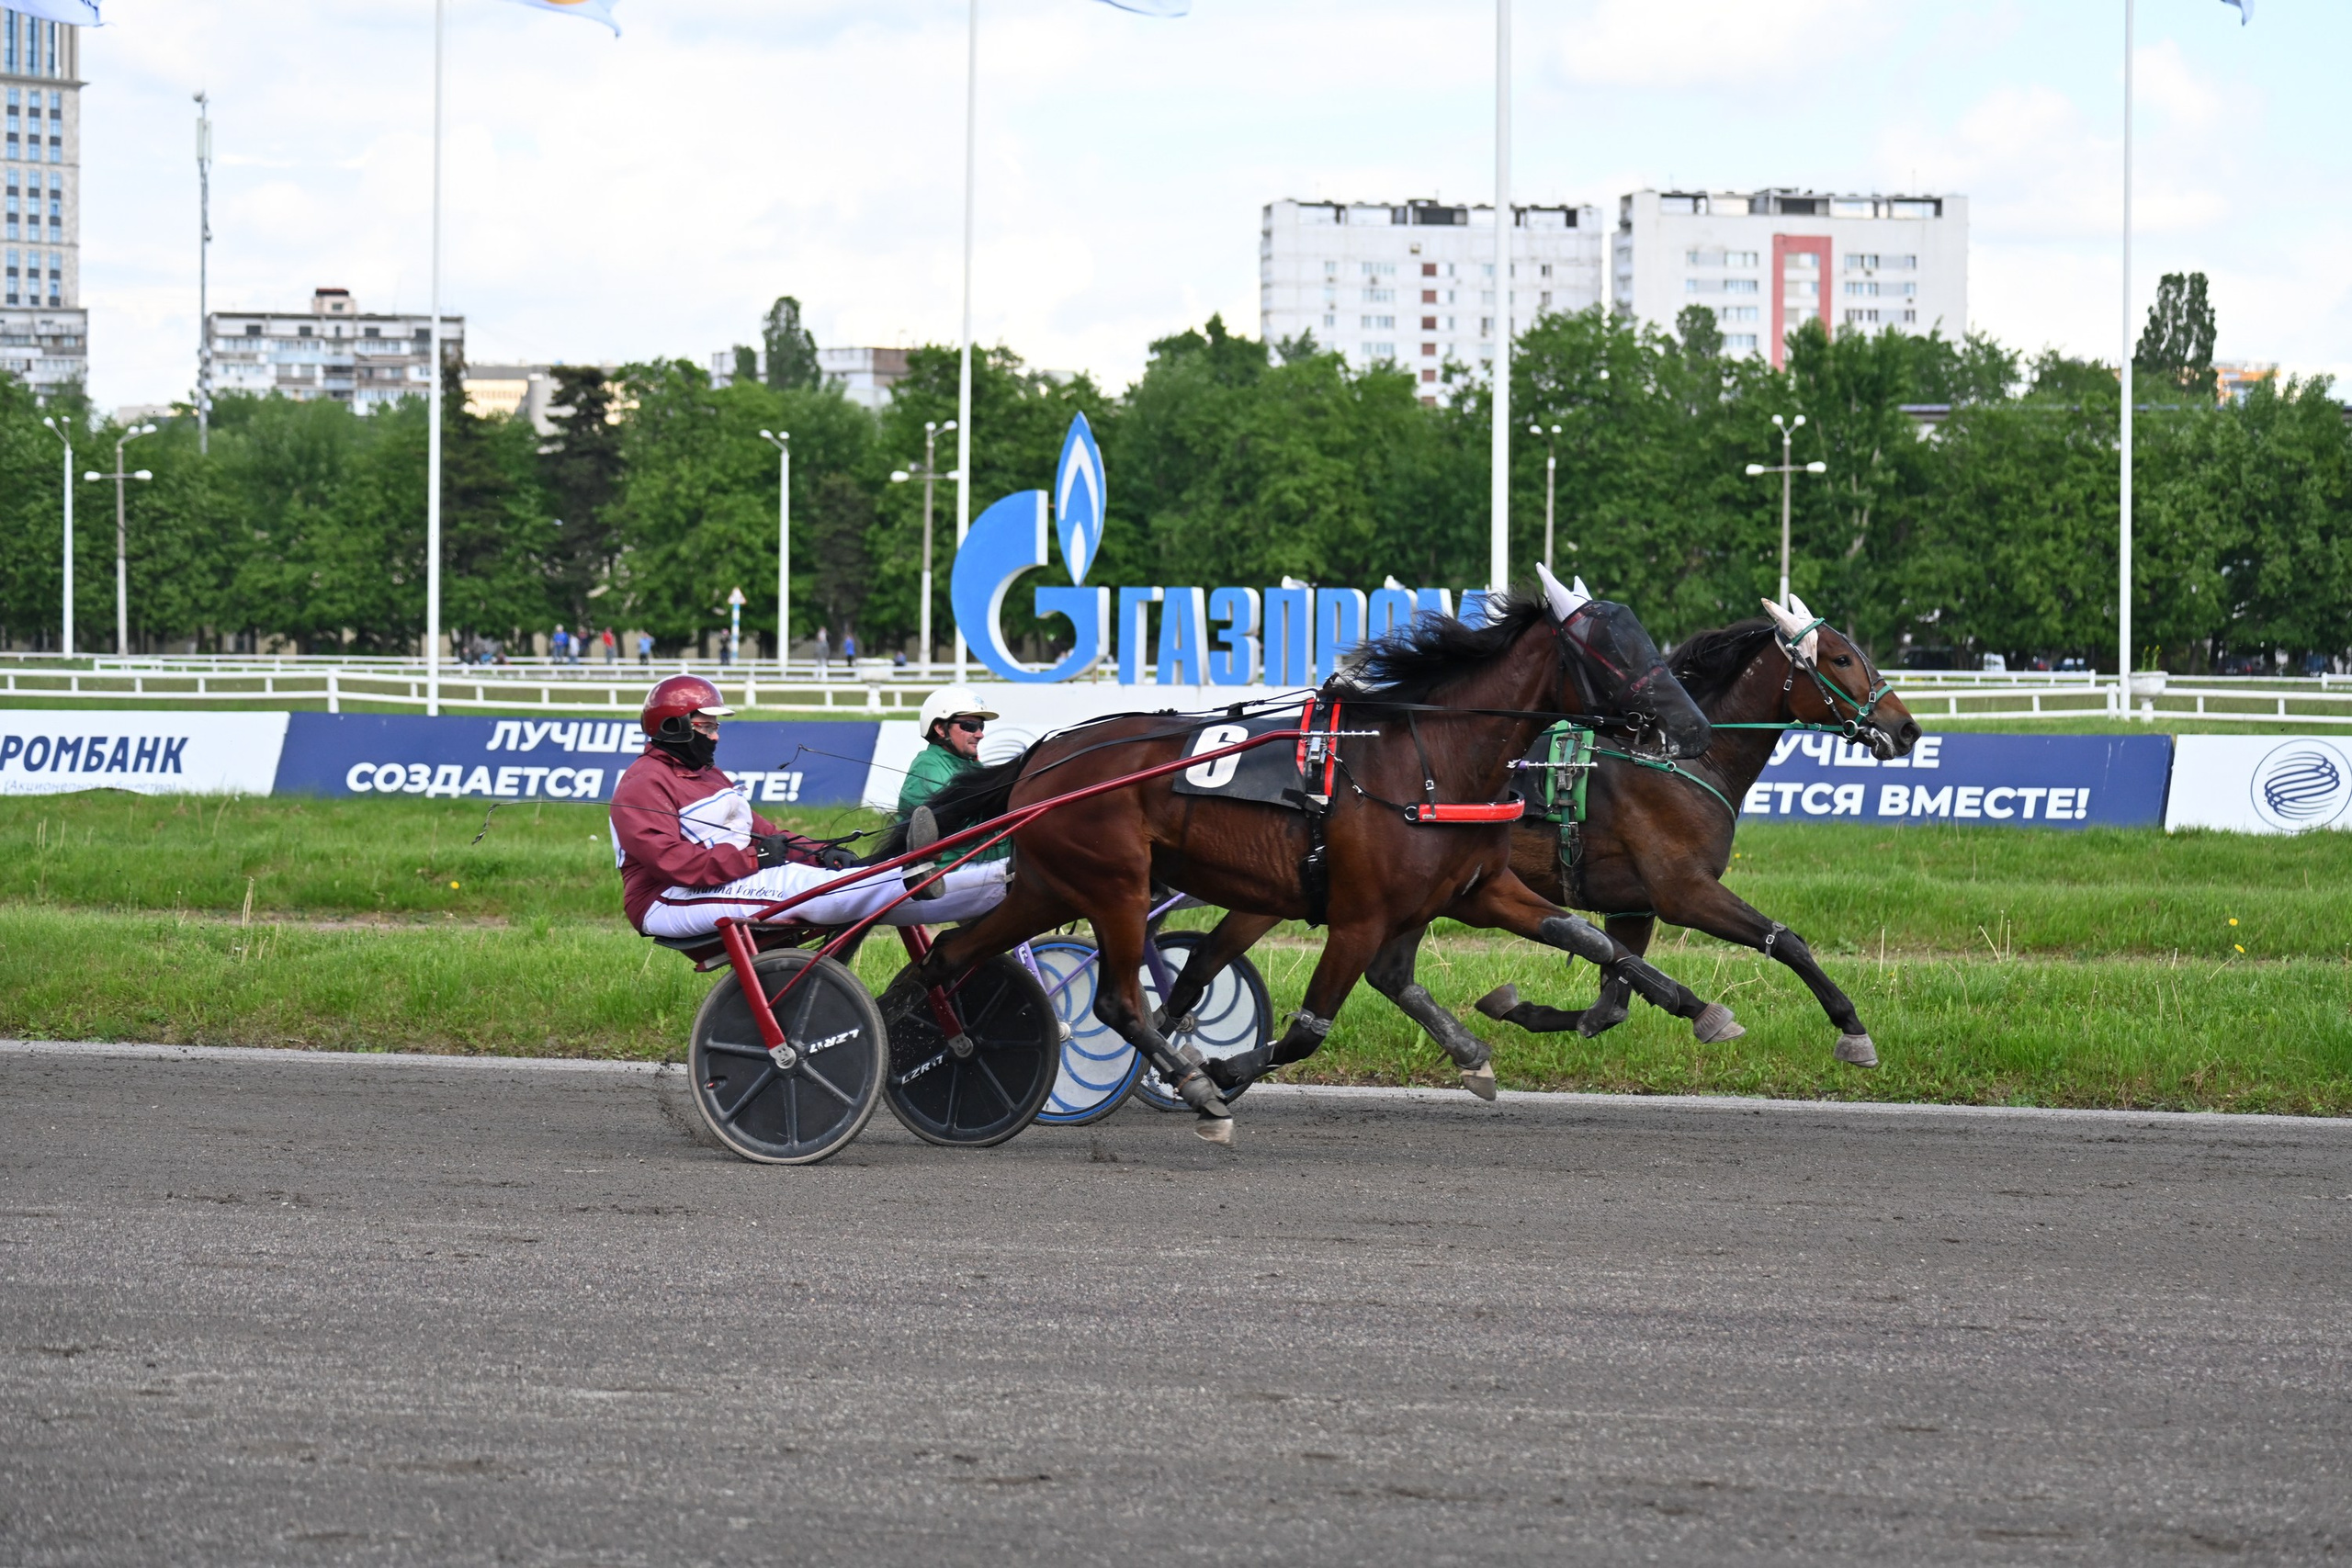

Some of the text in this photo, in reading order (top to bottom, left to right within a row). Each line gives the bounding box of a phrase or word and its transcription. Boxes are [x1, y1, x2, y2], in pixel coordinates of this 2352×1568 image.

[486, 720, 651, 754] ЛУЧШЕ
[1185, 724, 1250, 789] 6
[346, 761, 605, 799] СОЗДАЕТСЯ
[1878, 784, 2091, 821] ВМЕСТЕ!
